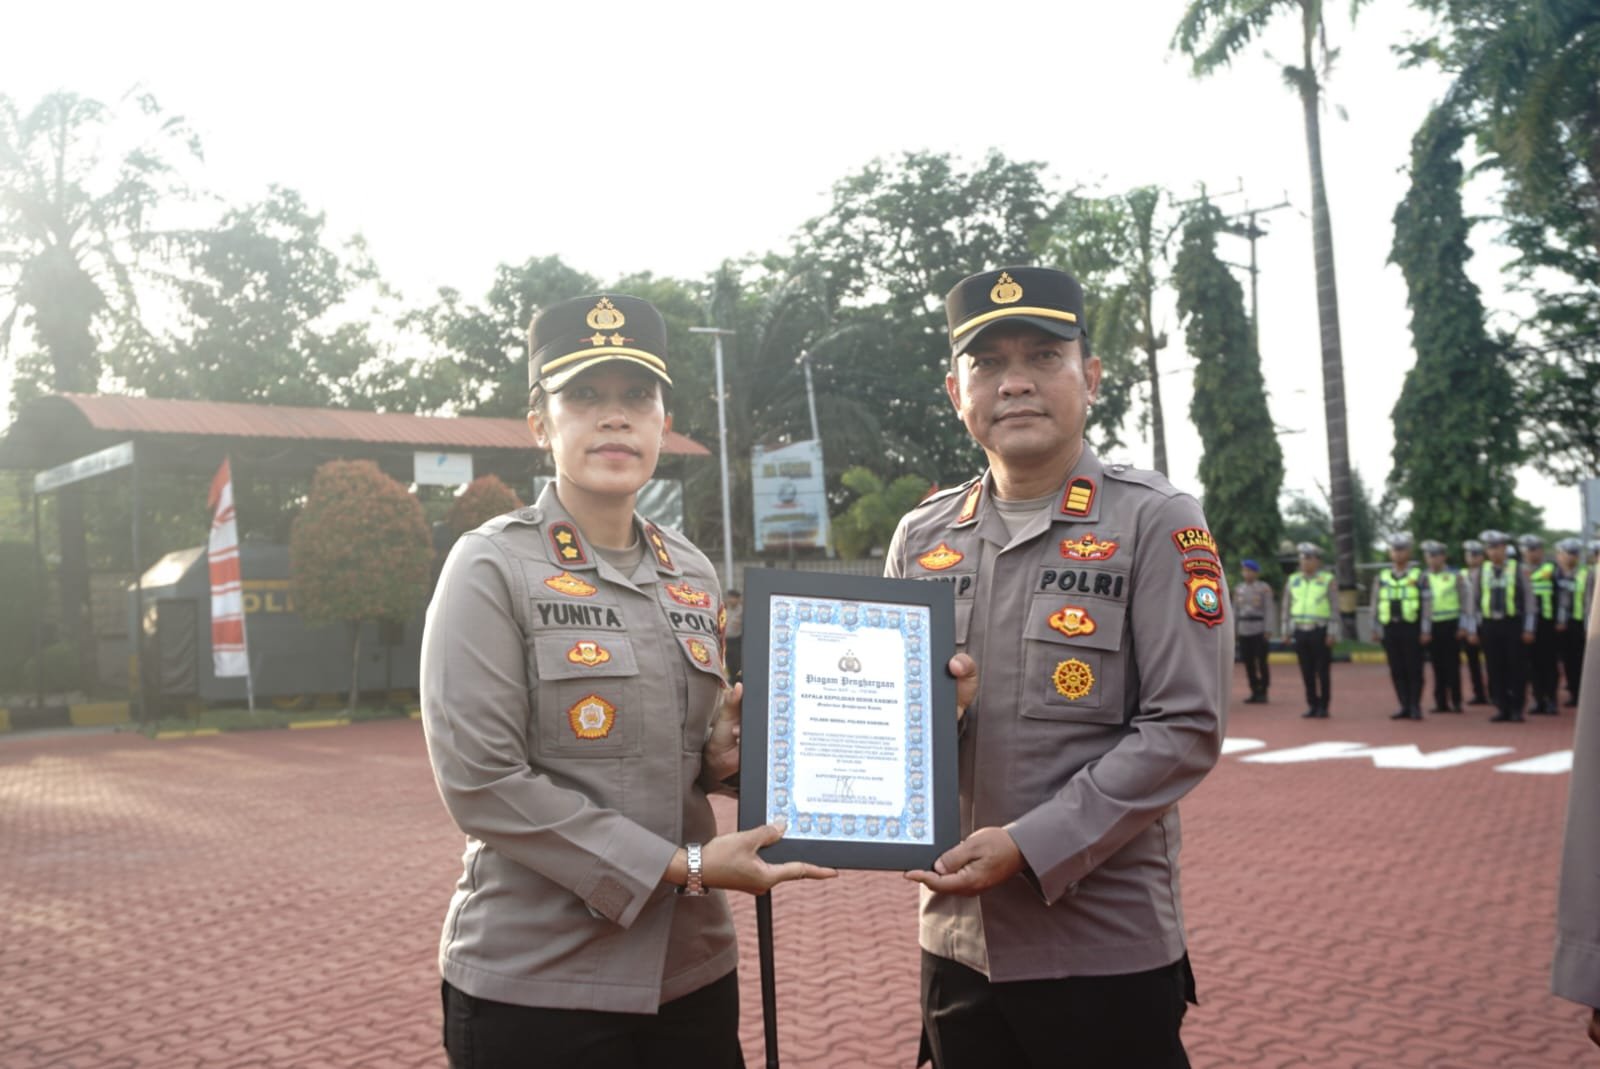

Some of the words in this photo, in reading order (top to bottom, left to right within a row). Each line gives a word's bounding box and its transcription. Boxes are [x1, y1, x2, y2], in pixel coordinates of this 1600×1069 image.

[1040, 570, 1124, 598] POLRI
[537, 603, 622, 628] YUNITA
[806, 674, 838, 685] Piagam
[841, 676, 895, 688] Penghargaan
